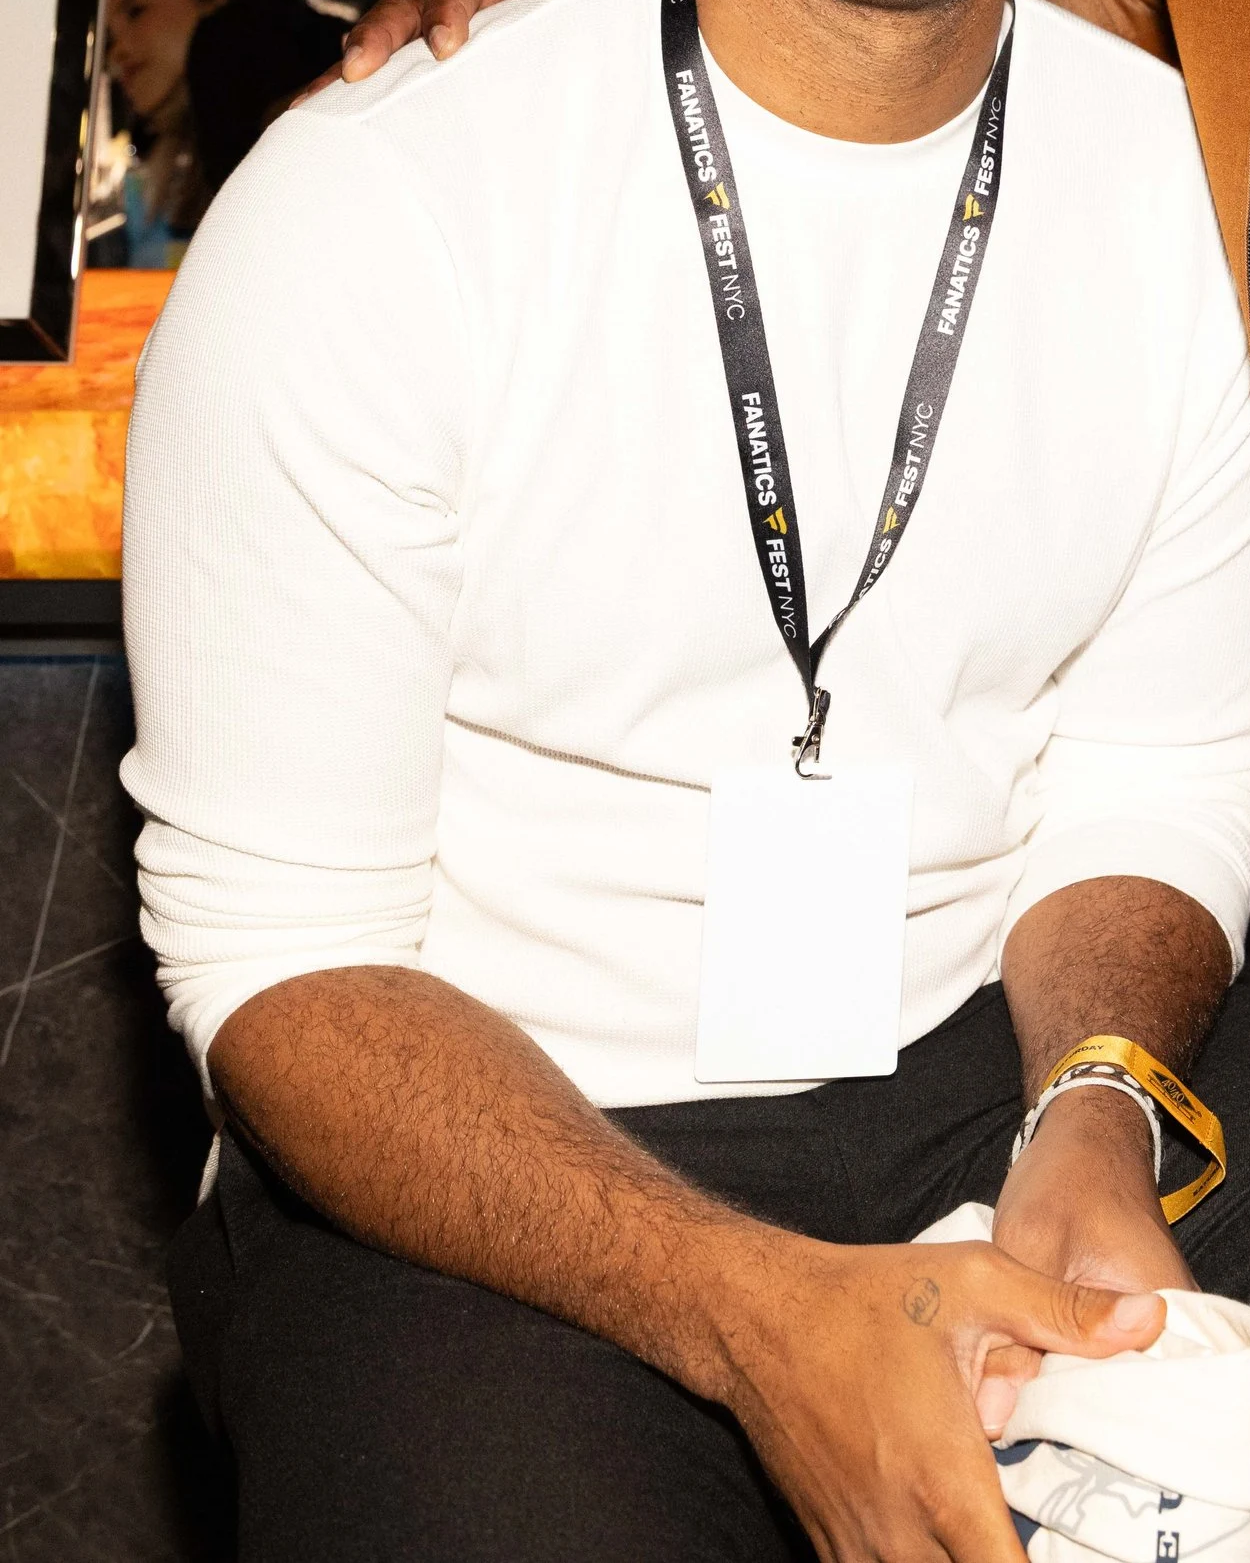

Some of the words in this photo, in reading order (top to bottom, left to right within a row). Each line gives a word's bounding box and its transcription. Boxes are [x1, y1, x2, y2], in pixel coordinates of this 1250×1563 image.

[675, 69, 717, 183] FANATICS
[985, 96, 1002, 140] NYC
[974, 140, 997, 196] FEST
[708, 215, 737, 272] FEST
[720, 272, 745, 320] NYC
[936, 225, 980, 335] FANATICS
[741, 391, 776, 507] FANATICS
[895, 449, 922, 507] FEST
[909, 402, 934, 448] NYC
[766, 538, 792, 592] FEST
[777, 594, 797, 639] NYC
